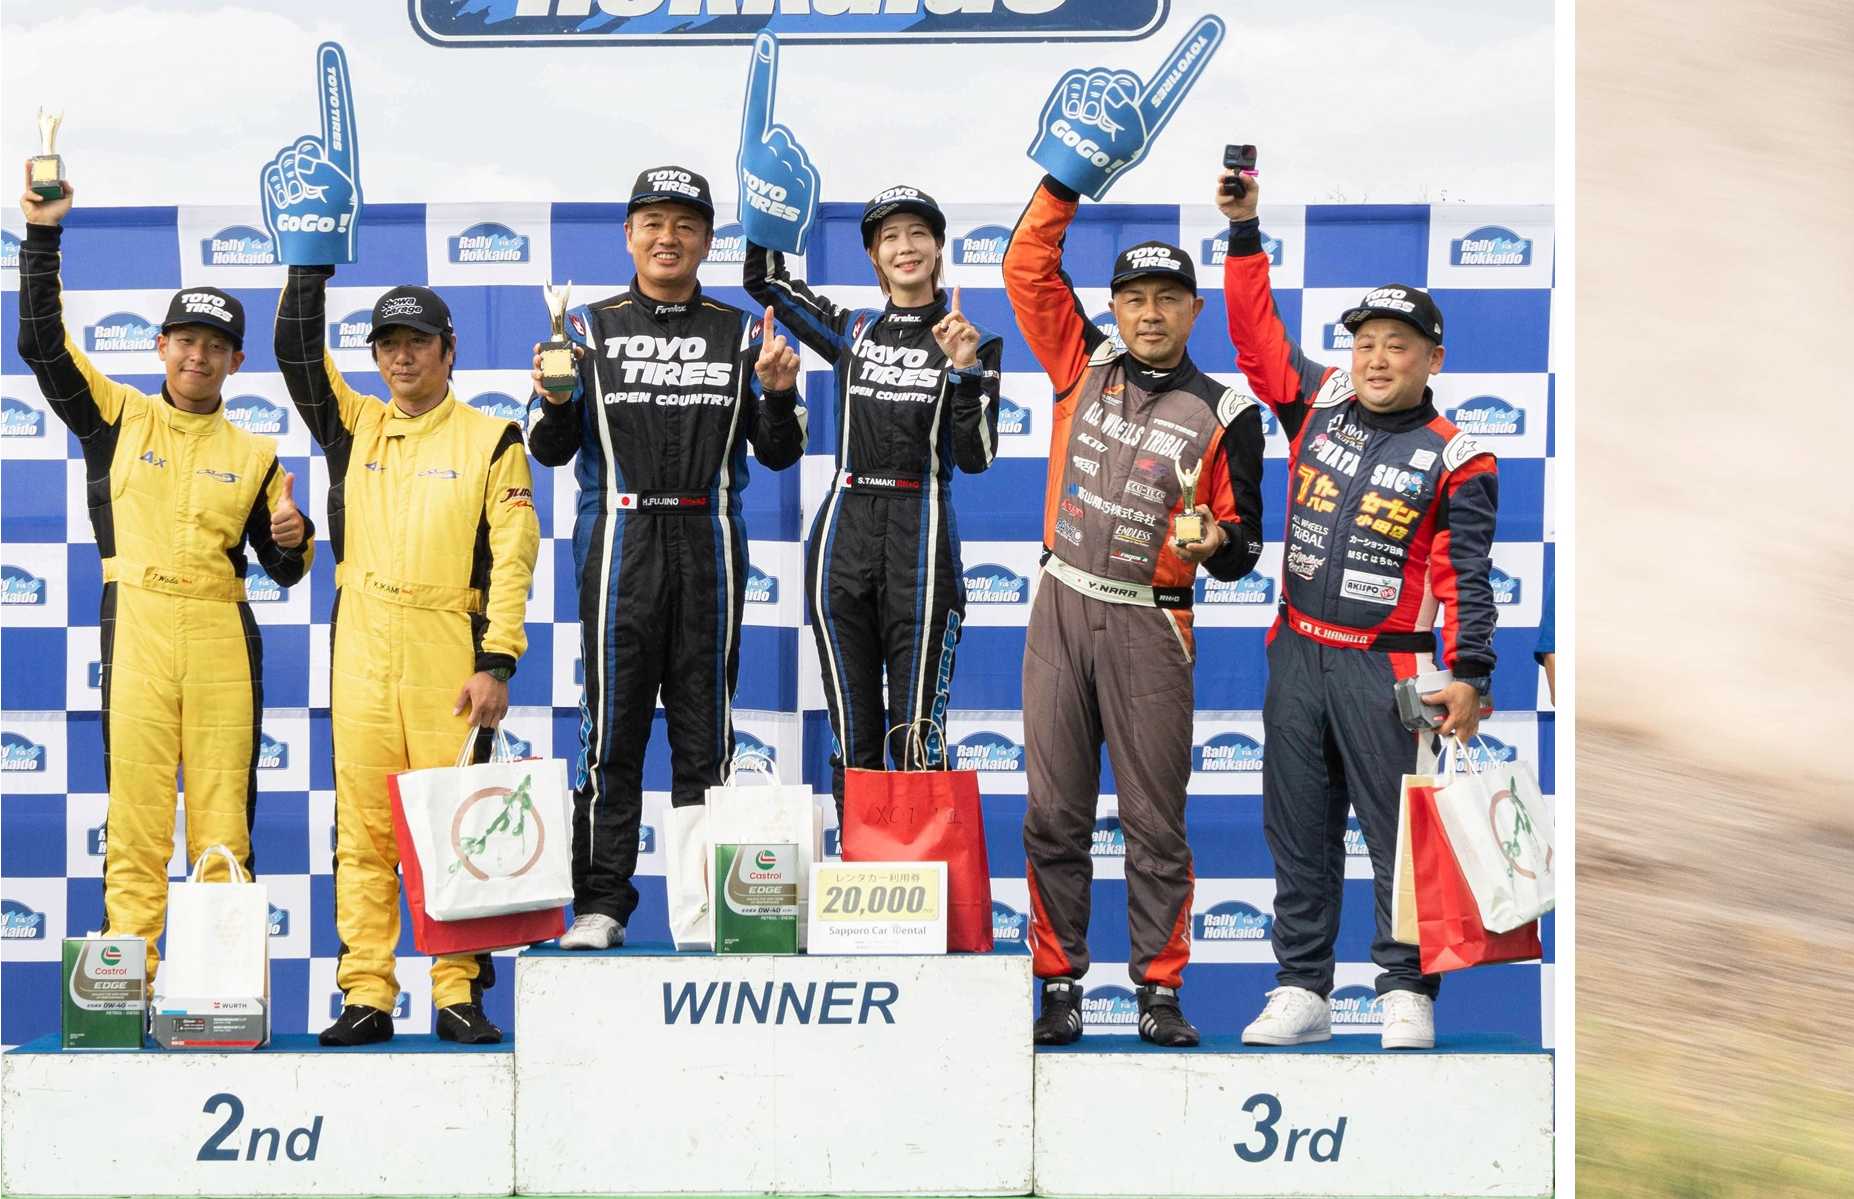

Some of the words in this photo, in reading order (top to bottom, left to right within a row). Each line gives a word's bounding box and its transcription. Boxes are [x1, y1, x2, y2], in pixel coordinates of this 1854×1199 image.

[1177, 36, 1208, 75] TOYO
[327, 67, 339, 108] TOYO
[1151, 70, 1182, 108] TIRES
[331, 109, 342, 151] TIRES
[647, 170, 691, 183] TOYO
[652, 181, 700, 197] TIRES
[743, 168, 787, 202] TOYO
[746, 187, 800, 222] TIRES
[212, 239, 245, 252] Rally
[458, 236, 493, 250] Rally
[963, 238, 995, 252] Rally
[1461, 239, 1495, 252] Rally
[212, 251, 275, 264] Hokkaido
[459, 249, 522, 262] Hokkaido
[1126, 247, 1171, 259] TOYO
[1460, 252, 1523, 265] Hokkaido
[1131, 257, 1181, 270] TIRES
[181, 292, 226, 307] TOYO
[1366, 289, 1407, 302] TOYO
[185, 303, 234, 322] TIRES
[1367, 299, 1416, 313] TIRES
[95, 326, 127, 338] Rally
[95, 338, 155, 350] Hokkaido
[604, 335, 707, 360] TOYO
[858, 339, 928, 368] TOYO
[621, 361, 733, 386] TIRES
[859, 361, 941, 387] TIRES
[604, 391, 651, 404] OPEN
[655, 393, 735, 407] COUNTRY
[849, 385, 874, 397] OPEN
[876, 390, 936, 404] COUNTRY
[1083, 401, 1104, 426] ALL
[1142, 429, 1188, 460] TRIBAL
[858, 477, 896, 487] S.TAMAKI
[642, 497, 679, 506] H.FUJINO
[1115, 525, 1152, 540] ENDLESS
[1301, 519, 1329, 536] WHEELS
[1088, 581, 1138, 598] Y.NARA
[1347, 582, 1378, 593] AKISPO
[1204, 590, 1266, 603] Hokkaido
[937, 608, 960, 693] TIRES
[957, 745, 990, 757] Rally
[1203, 746, 1236, 758] Rally
[956, 757, 1019, 771] Hokkaido
[1203, 757, 1264, 771] Hokkaido
[749, 871, 782, 880] Castrol
[749, 886, 783, 894] EDGE
[822, 886, 926, 917] 20,000
[1204, 914, 1237, 927] Rally
[829, 926, 871, 936] Sapporo
[872, 927, 888, 935] Car
[1204, 926, 1265, 939] Hokkaido
[95, 967, 127, 976] Castrol
[94, 981, 128, 989] EDGE
[662, 981, 900, 1025] WINNER
[1082, 998, 1114, 1011] Rally
[196, 1093, 324, 1161] 2nd
[1233, 1093, 1348, 1162] 3rd
